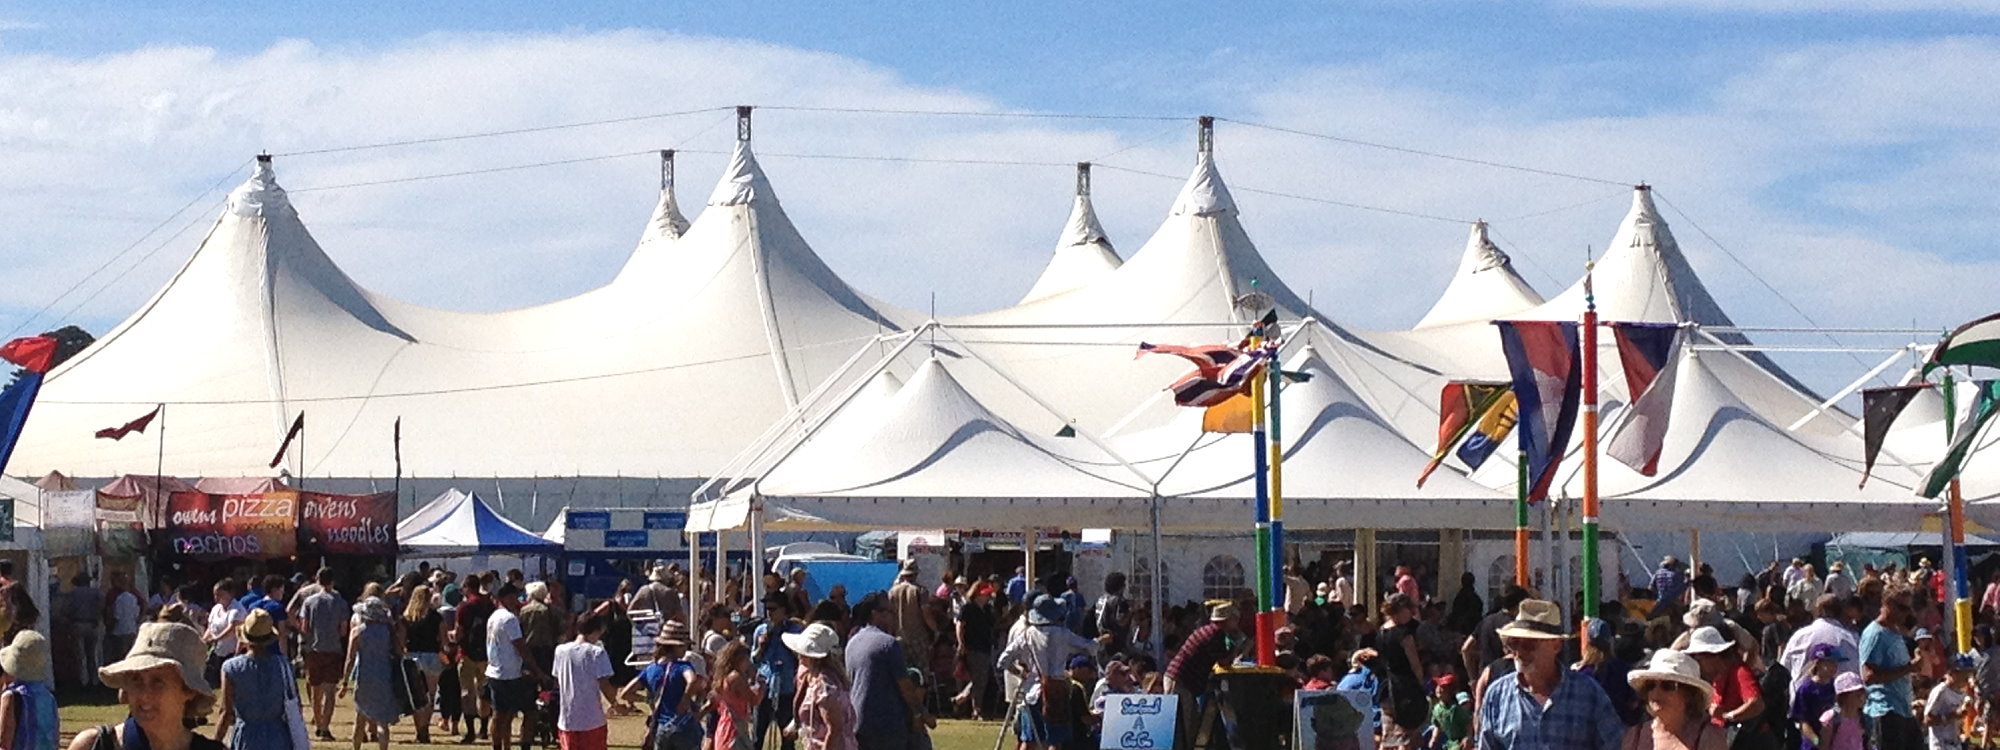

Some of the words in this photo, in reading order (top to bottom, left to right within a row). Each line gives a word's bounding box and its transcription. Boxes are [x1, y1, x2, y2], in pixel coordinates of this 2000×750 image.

[222, 495, 293, 524] pizza
[304, 497, 358, 519] owens
[327, 517, 390, 543] noodles
[173, 531, 261, 554] nachos
[1132, 716, 1145, 730] A
